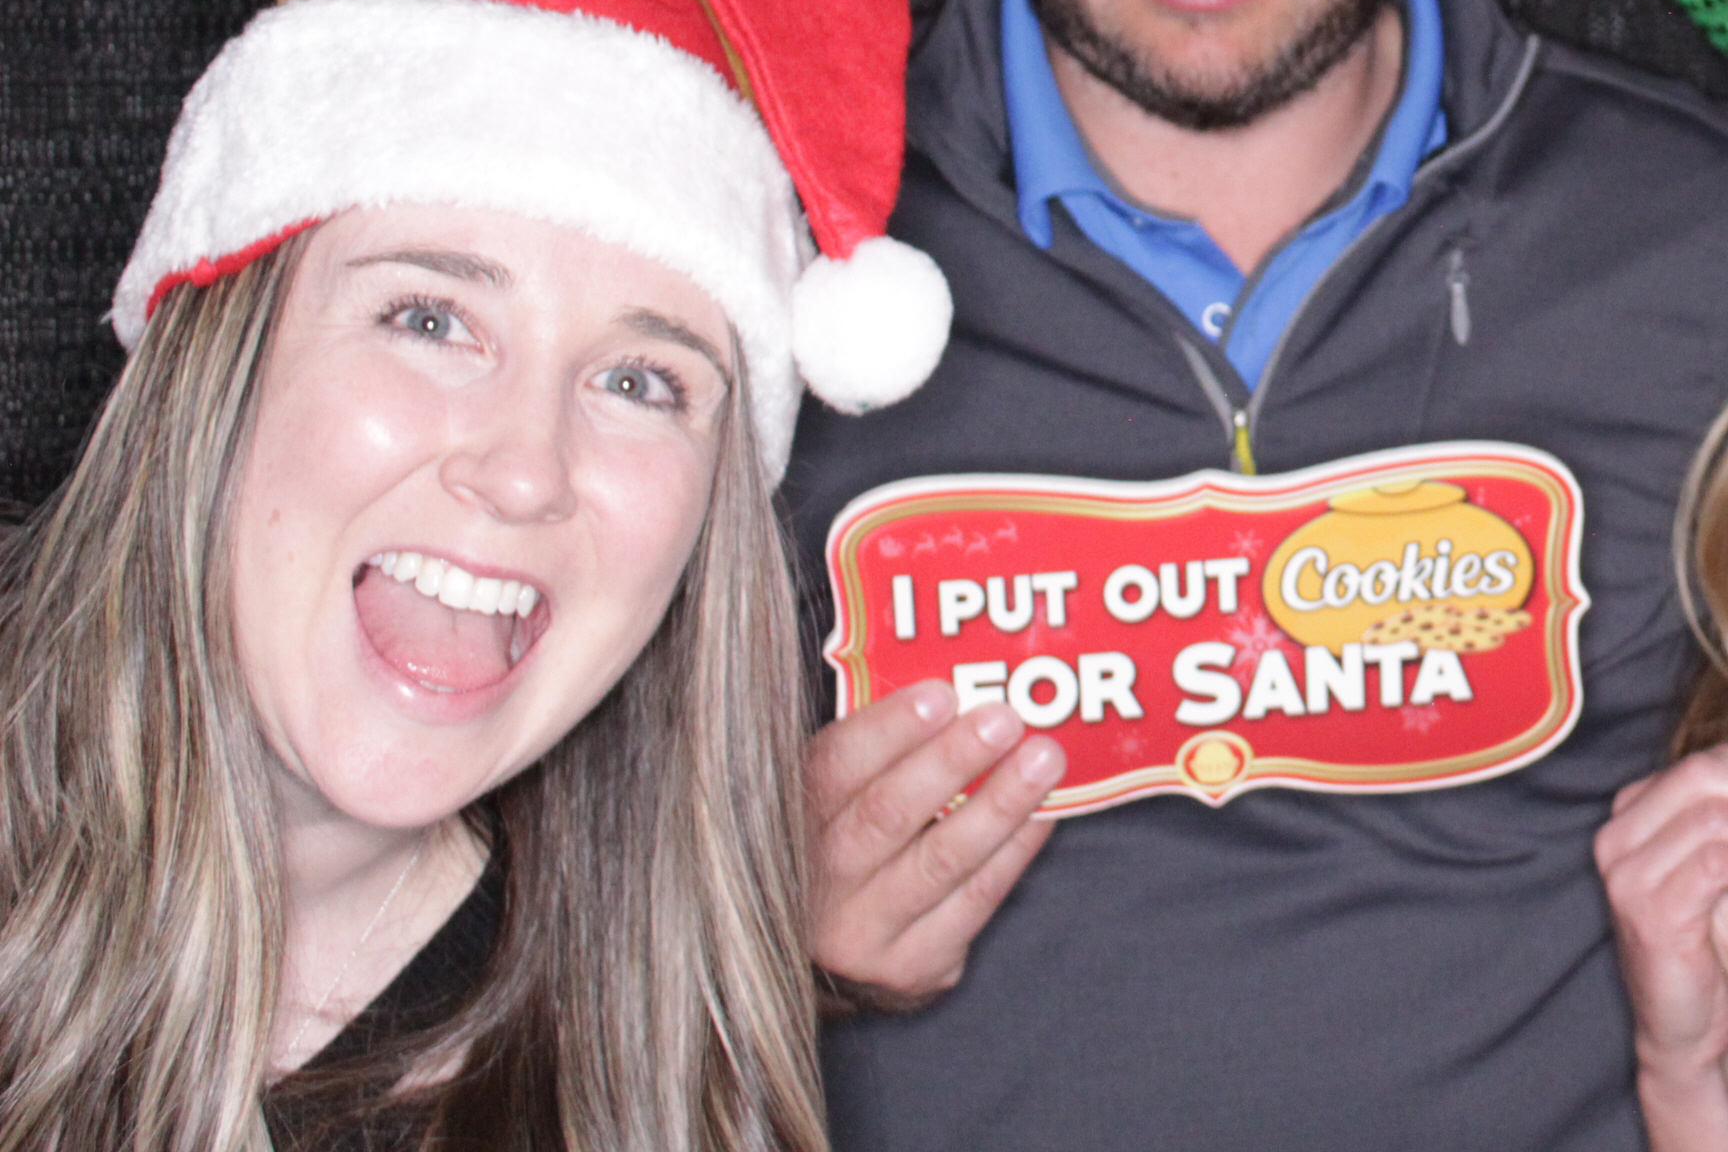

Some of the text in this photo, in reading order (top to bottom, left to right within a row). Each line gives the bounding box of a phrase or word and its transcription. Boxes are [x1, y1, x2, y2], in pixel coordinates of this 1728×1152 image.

[893, 540, 1517, 639] I PUT OUT Cookies
[953, 641, 1472, 727] FOR SANTA
